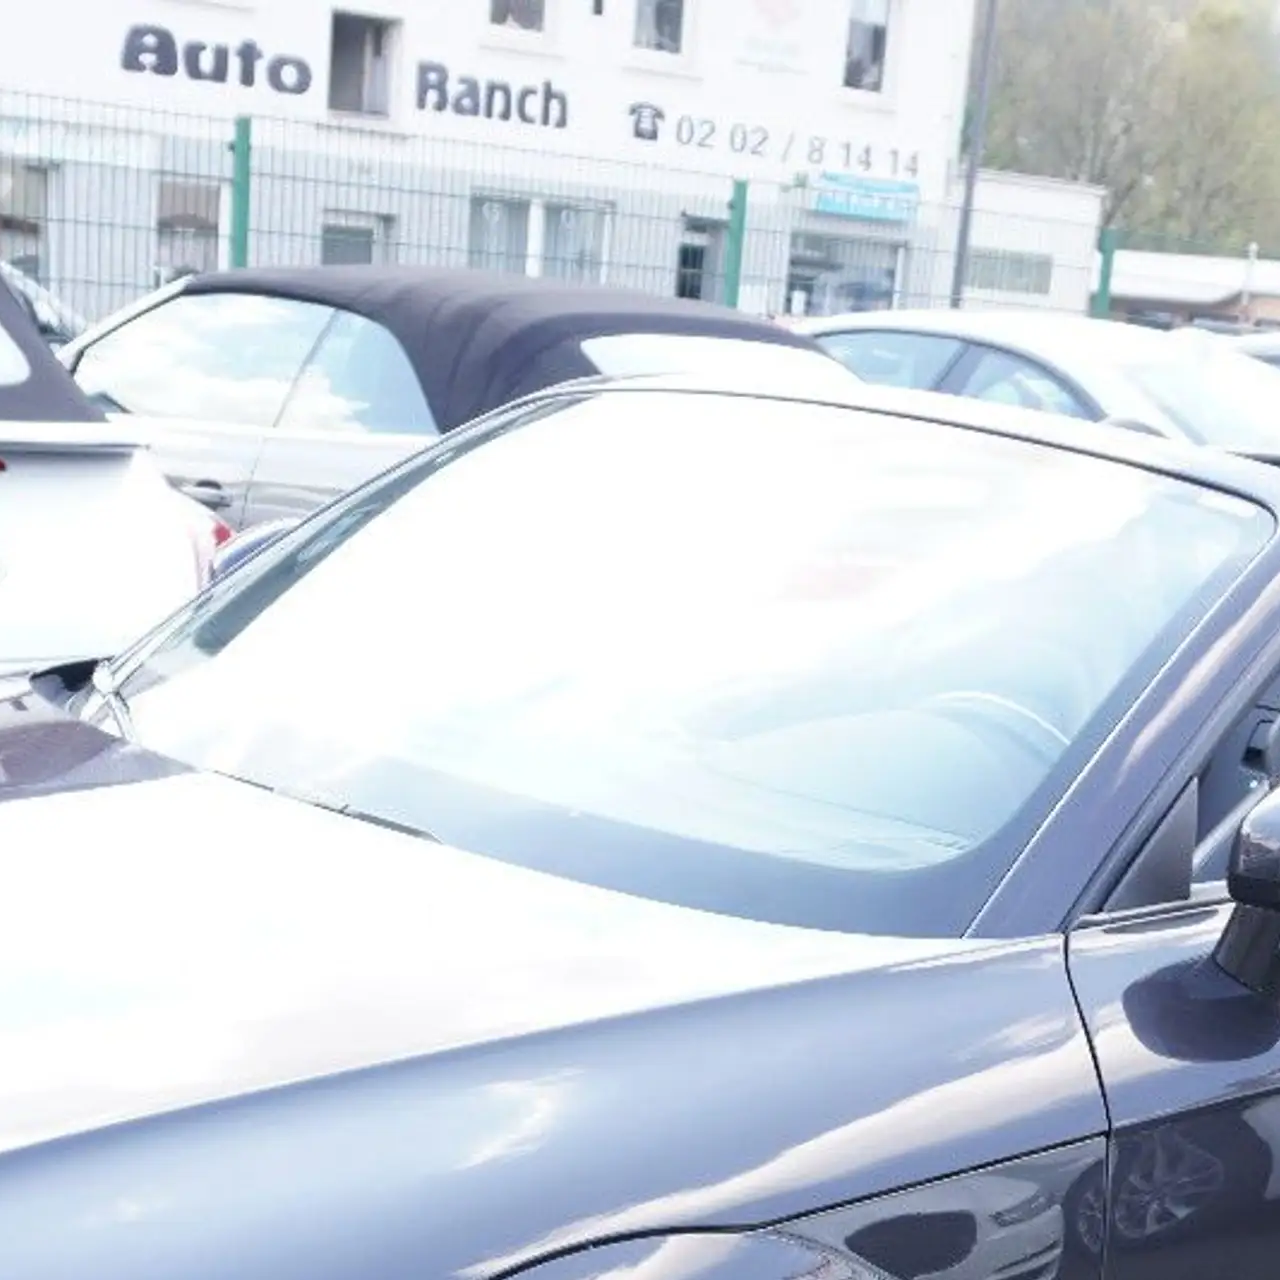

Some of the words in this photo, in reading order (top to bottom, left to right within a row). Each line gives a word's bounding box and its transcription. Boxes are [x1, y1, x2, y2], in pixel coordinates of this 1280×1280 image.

[121, 23, 313, 96] Auto
[416, 61, 569, 130] Ranch
[675, 114, 716, 149] 02
[729, 122, 769, 157] 02
[806, 135, 828, 165] 8
[841, 140, 872, 172] 14
[888, 148, 919, 177] 14
